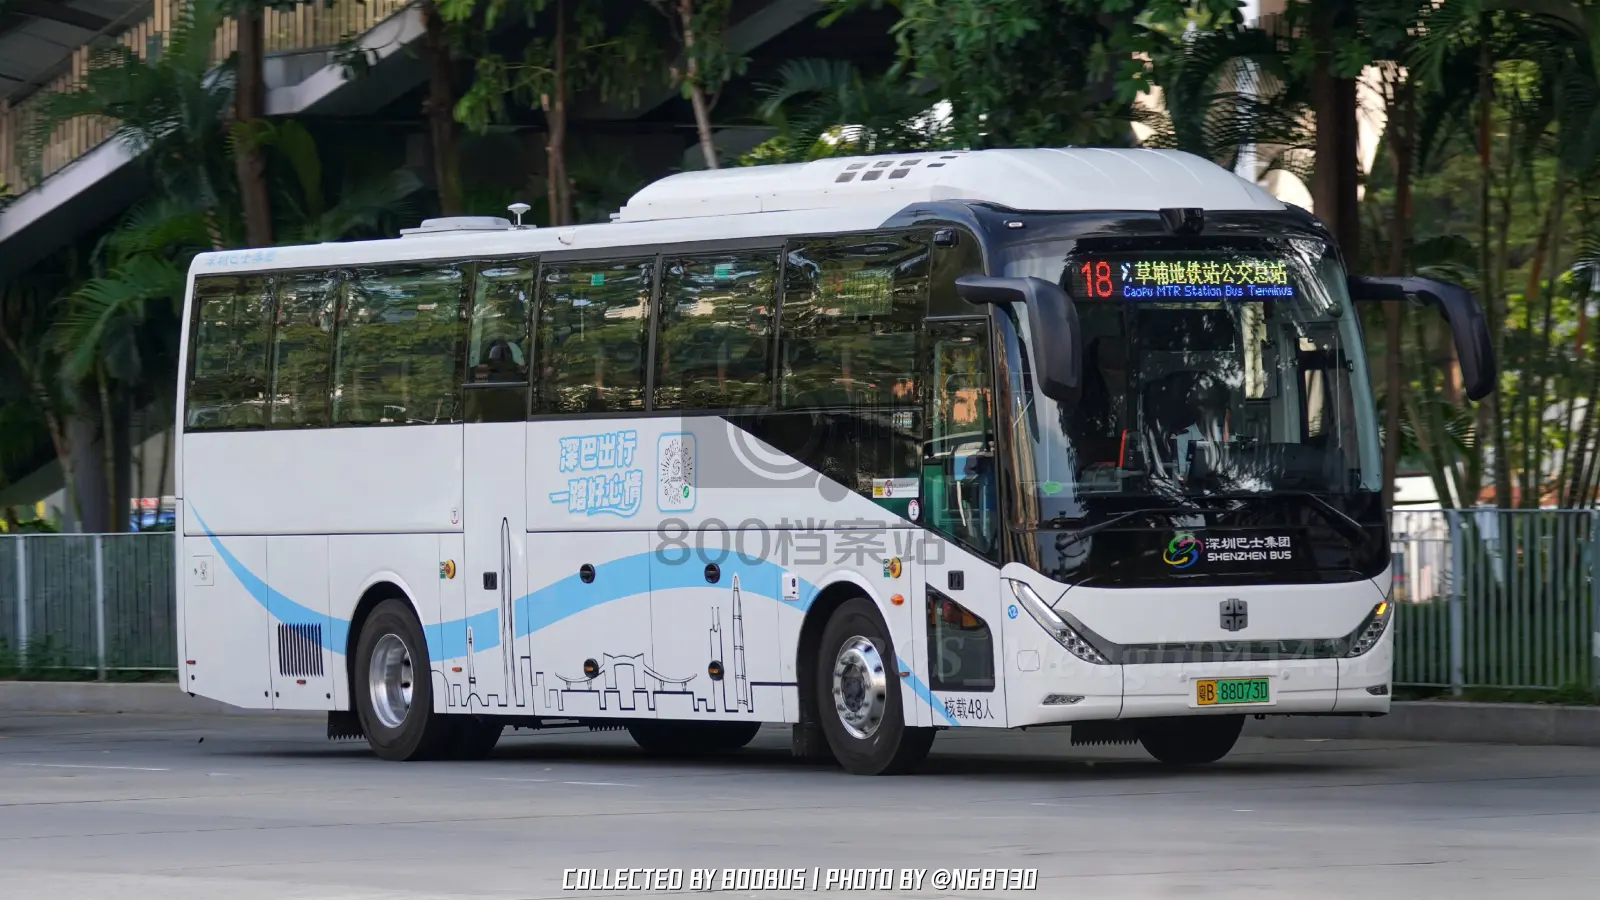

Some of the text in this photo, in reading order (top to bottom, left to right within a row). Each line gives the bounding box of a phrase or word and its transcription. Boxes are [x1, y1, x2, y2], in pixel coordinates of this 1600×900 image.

[1080, 261, 1112, 298] 18
[1135, 260, 1288, 285] 草埔地铁站公交总站
[1156, 285, 1182, 297] MTR
[1184, 285, 1222, 297] Station
[1225, 285, 1243, 296] Bus
[1247, 284, 1293, 296] Terminus
[559, 429, 637, 473] 深巴出行
[549, 469, 643, 516] 一路好心情
[1205, 535, 1291, 550] 深圳巴士集团
[1207, 550, 1292, 562] SHENZHEN BUS
[944, 696, 995, 720] 核载48人
